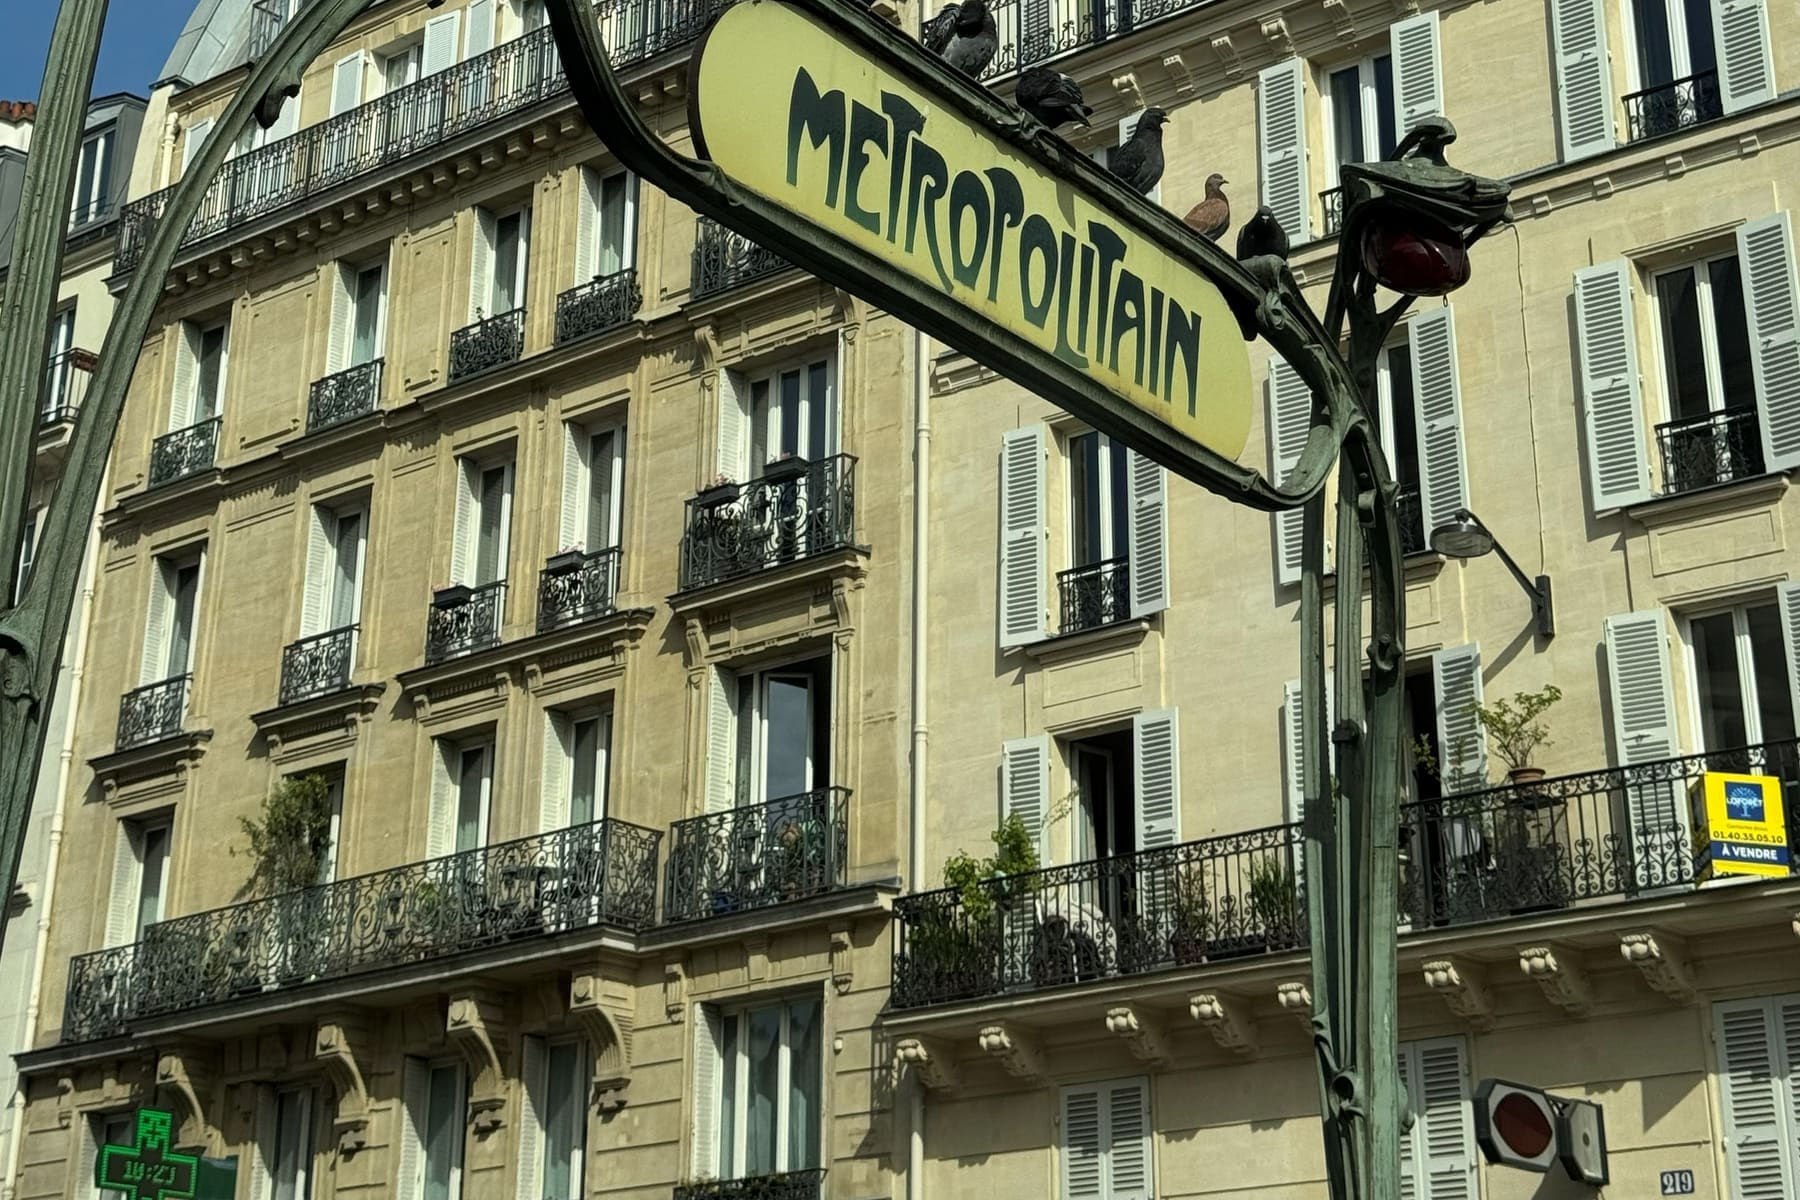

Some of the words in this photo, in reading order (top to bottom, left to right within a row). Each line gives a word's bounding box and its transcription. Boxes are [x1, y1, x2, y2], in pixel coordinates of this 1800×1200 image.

[786, 66, 1201, 418] METROPOLITAIN
[1731, 846, 1778, 860] VENDRE
[1663, 1172, 1692, 1193] 219
